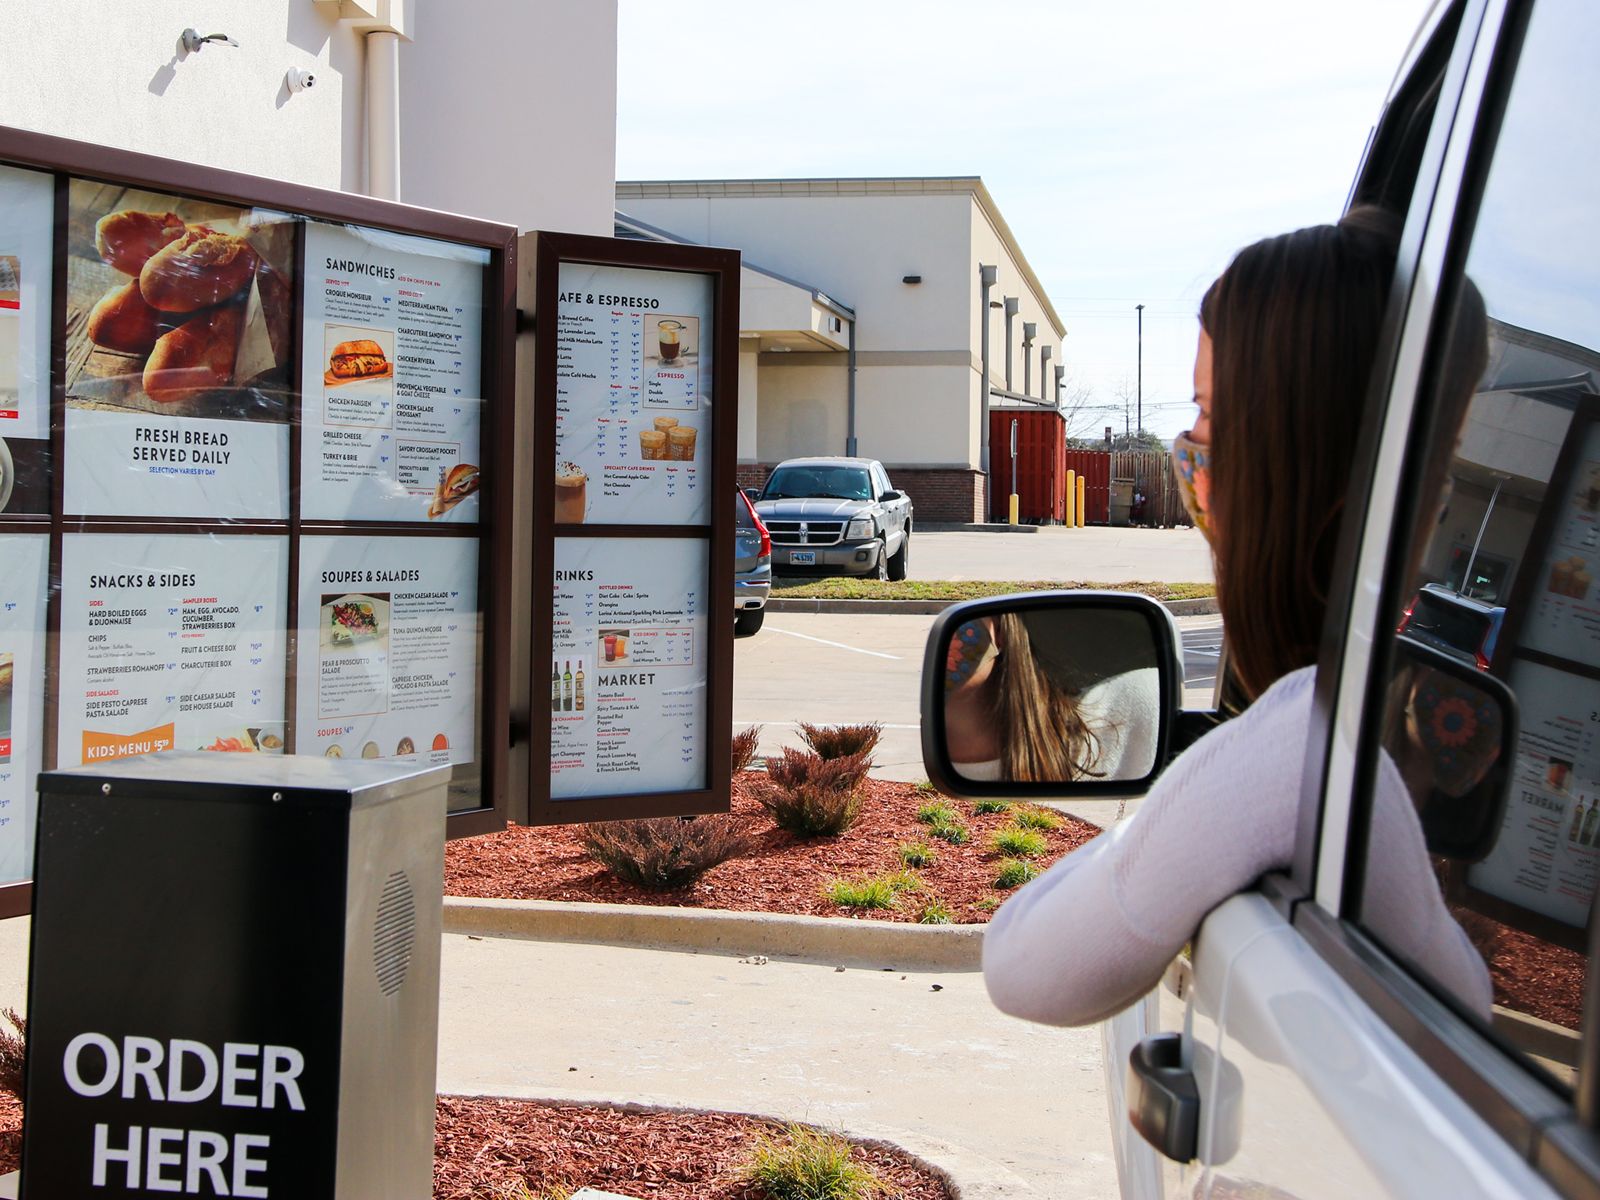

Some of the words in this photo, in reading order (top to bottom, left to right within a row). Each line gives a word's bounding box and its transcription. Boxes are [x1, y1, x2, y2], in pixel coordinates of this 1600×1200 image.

[326, 257, 395, 279] SANDWICHES
[325, 289, 346, 298] CROQUE
[346, 292, 372, 301] MONSIEUR
[398, 300, 435, 311] MEDITERRANEAN
[436, 304, 448, 312] TUNA
[559, 293, 582, 304] AFE
[586, 294, 594, 304] &
[599, 295, 659, 309] ESPRESSO
[398, 328, 428, 337] CHARCUTERIE
[429, 332, 452, 340] SANDWICH
[397, 383, 422, 391] PROVENÇAL
[422, 385, 446, 394] VEGETABLE
[414, 391, 430, 399] CHEESE
[350, 399, 372, 407] PARISIEN
[136, 428, 178, 443] FRESH
[185, 431, 228, 446] BREAD
[133, 447, 186, 462] SERVED
[192, 450, 230, 464] DAILY
[149, 466, 178, 474] SELECTION
[90, 574, 143, 588] SNACKS
[148, 574, 156, 587] &
[160, 574, 196, 587] SIDES
[322, 571, 363, 583] SOUPES
[366, 571, 372, 582] &
[376, 570, 419, 582] SALADES
[556, 570, 593, 581] RINKS
[89, 610, 106, 618] HARD
[131, 609, 147, 617] EGGS
[94, 618, 132, 626] DIJONNAISE
[182, 622, 223, 630] STRAWBERRIES
[632, 618, 651, 626] Sparkling
[182, 646, 197, 654] FRUIT
[181, 661, 219, 669] CHARCUTERIE
[339, 658, 369, 666] PROSCIUTTO
[87, 666, 131, 676] STRAWBERRIES
[133, 664, 165, 672] ROMANOFF
[322, 667, 341, 675] SALADE
[598, 674, 655, 686] MARKET
[194, 693, 214, 702] CAESAR
[215, 692, 236, 700] SALADE
[102, 700, 120, 708] PESTO
[122, 698, 148, 707] CAPRESE
[179, 704, 192, 712] SIDE
[194, 703, 212, 711] HOUSE
[213, 701, 233, 709] SALADE
[86, 710, 105, 718] PASTA
[106, 708, 128, 717] SALADE
[318, 728, 343, 737] SOUPES
[88, 745, 115, 758] KIDS
[118, 741, 151, 755] MENU
[63, 1032, 306, 1112] ORDER
[92, 1122, 270, 1199] HERE
